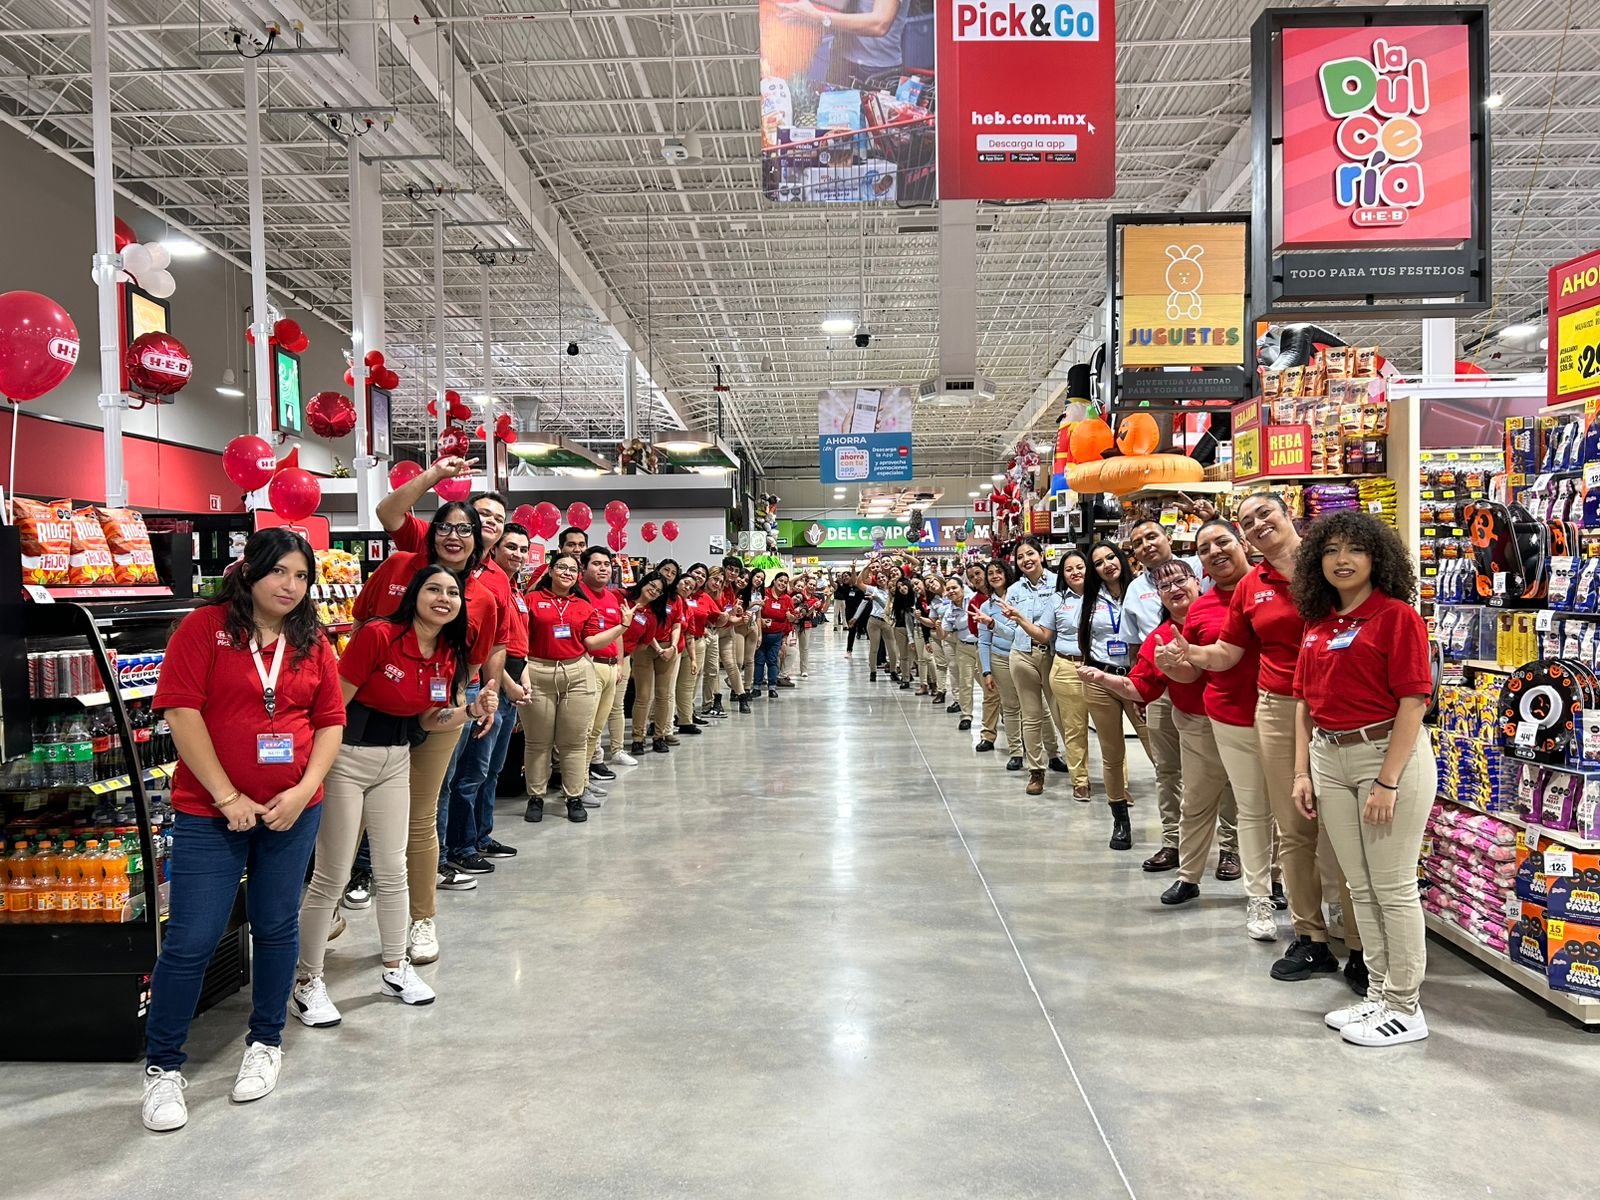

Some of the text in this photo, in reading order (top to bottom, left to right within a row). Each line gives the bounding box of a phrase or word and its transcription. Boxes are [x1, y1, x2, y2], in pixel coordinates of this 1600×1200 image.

[957, 1, 1095, 37] Pick&Go
[1373, 38, 1407, 73] la
[971, 111, 1087, 125] heb.com.mx
[988, 139, 1065, 149] Descarga la app
[1290, 266, 1465, 278] TODO PARA TUS FESTEJOS
[1128, 327, 1240, 346] JUGUETES
[825, 436, 867, 445] AHORRA
[1269, 432, 1302, 450] REBA
[1270, 449, 1303, 467] JADO
[827, 527, 857, 540] DEL
[1509, 907, 1519, 916] 125
[1550, 924, 1561, 934] 15
